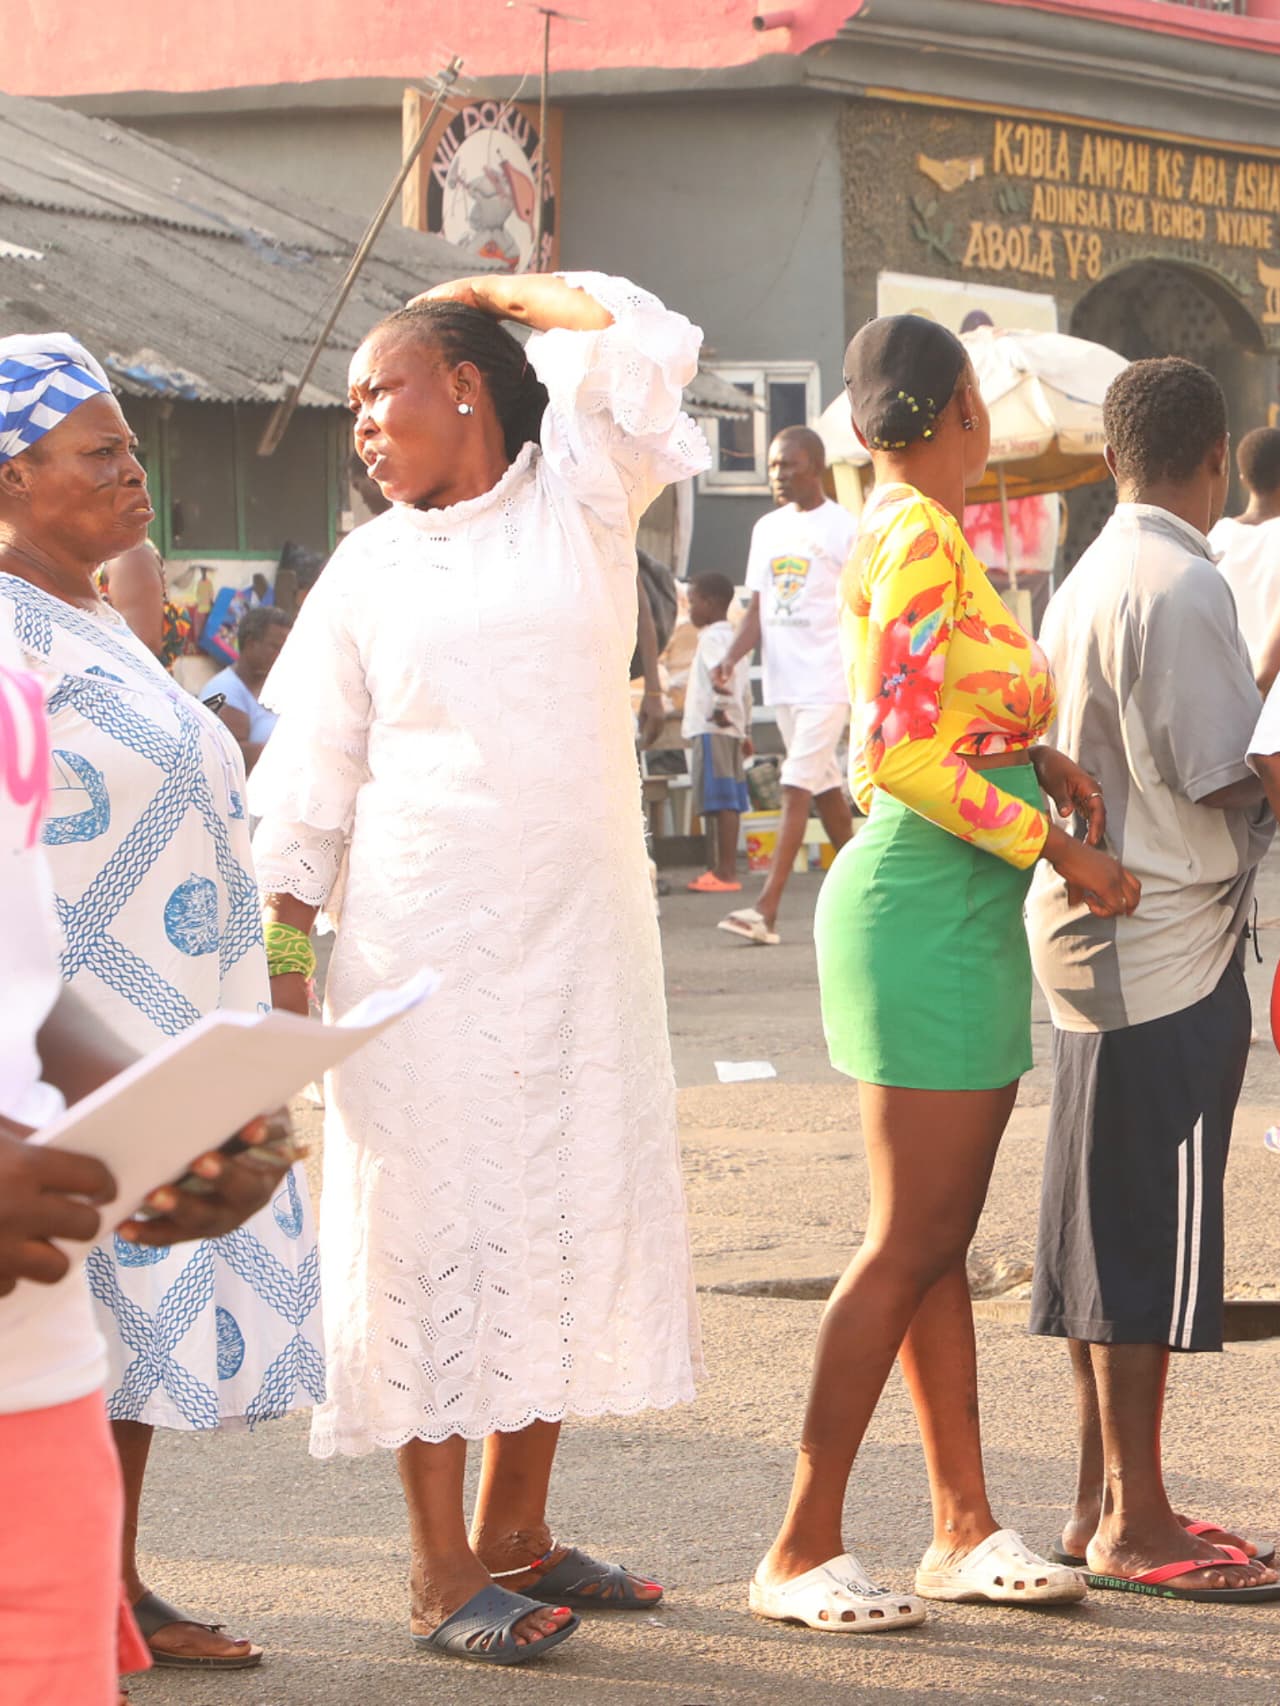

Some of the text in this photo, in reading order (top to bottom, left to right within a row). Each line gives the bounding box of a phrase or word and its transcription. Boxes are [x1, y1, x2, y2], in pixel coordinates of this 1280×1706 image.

[1080, 135, 1149, 192] AMPAH
[1190, 156, 1227, 205] ABA
[963, 223, 1055, 277] ABOLA
[1216, 211, 1272, 246] NYAME
[1088, 1575, 1127, 1589] VICTORY
